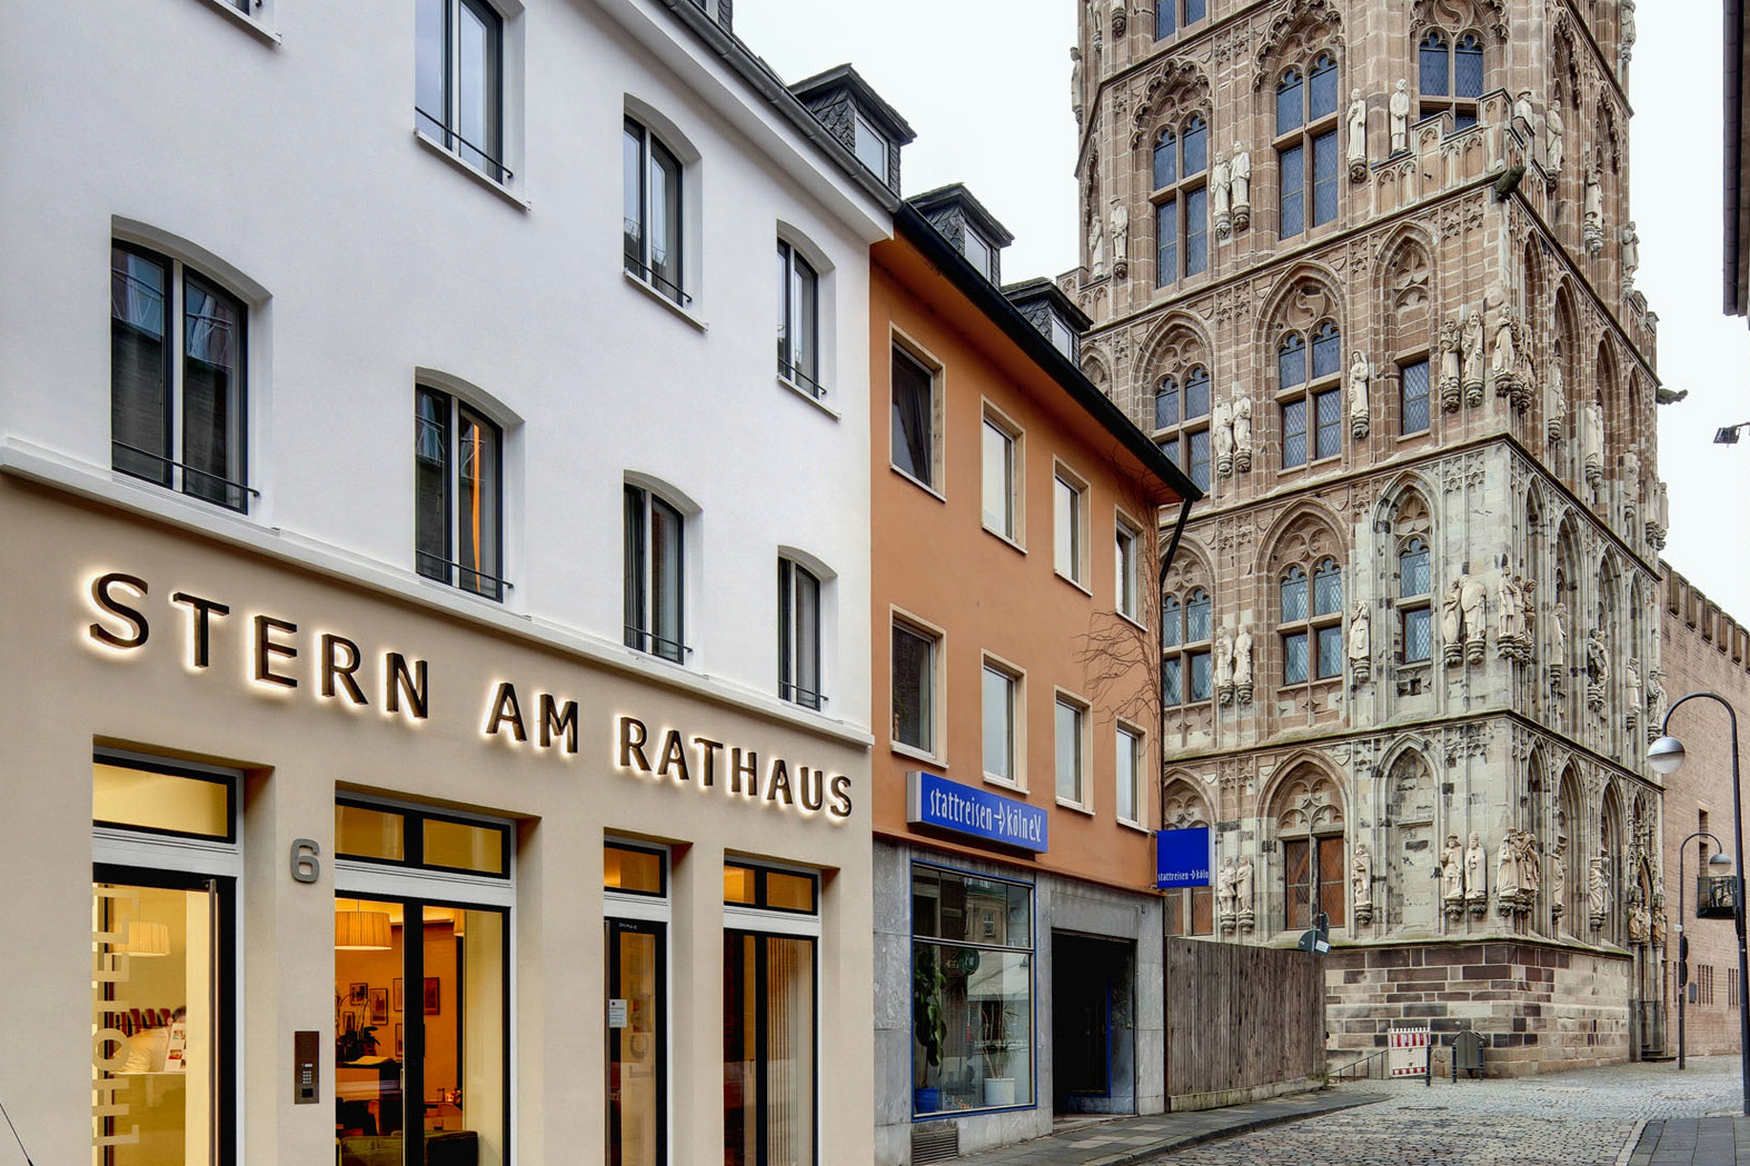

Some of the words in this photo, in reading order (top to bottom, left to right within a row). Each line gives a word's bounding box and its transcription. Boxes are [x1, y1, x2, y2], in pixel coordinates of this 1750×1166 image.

[89, 572, 428, 719] STERN
[486, 682, 578, 754] AM
[619, 716, 852, 818] RATHAUS
[930, 787, 992, 832] stattreisen
[290, 838, 320, 884] 6
